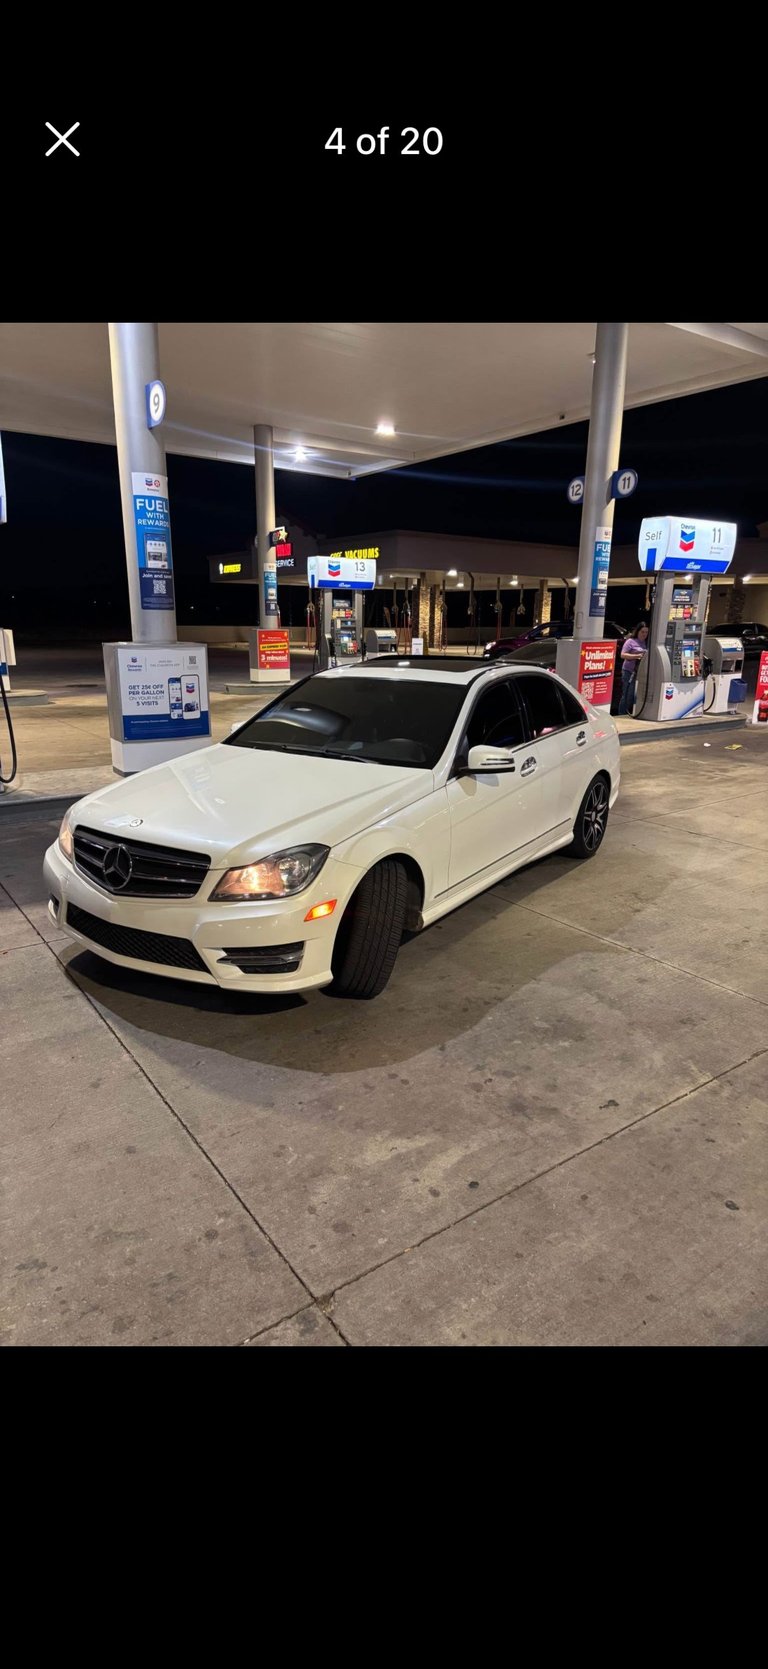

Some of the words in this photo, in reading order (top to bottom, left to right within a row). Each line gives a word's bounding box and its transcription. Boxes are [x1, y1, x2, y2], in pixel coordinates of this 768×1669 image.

[153, 393, 160, 413] 9
[621, 476, 631, 490] 11
[571, 484, 582, 497] 12
[136, 498, 168, 513] FUEL
[146, 512, 164, 520] WITH
[645, 531, 662, 541] Self
[713, 527, 721, 543] 11
[345, 547, 379, 559] VACUUMS
[596, 543, 610, 552] FUE
[355, 562, 366, 572] 13
[584, 661, 606, 670] Plans!
